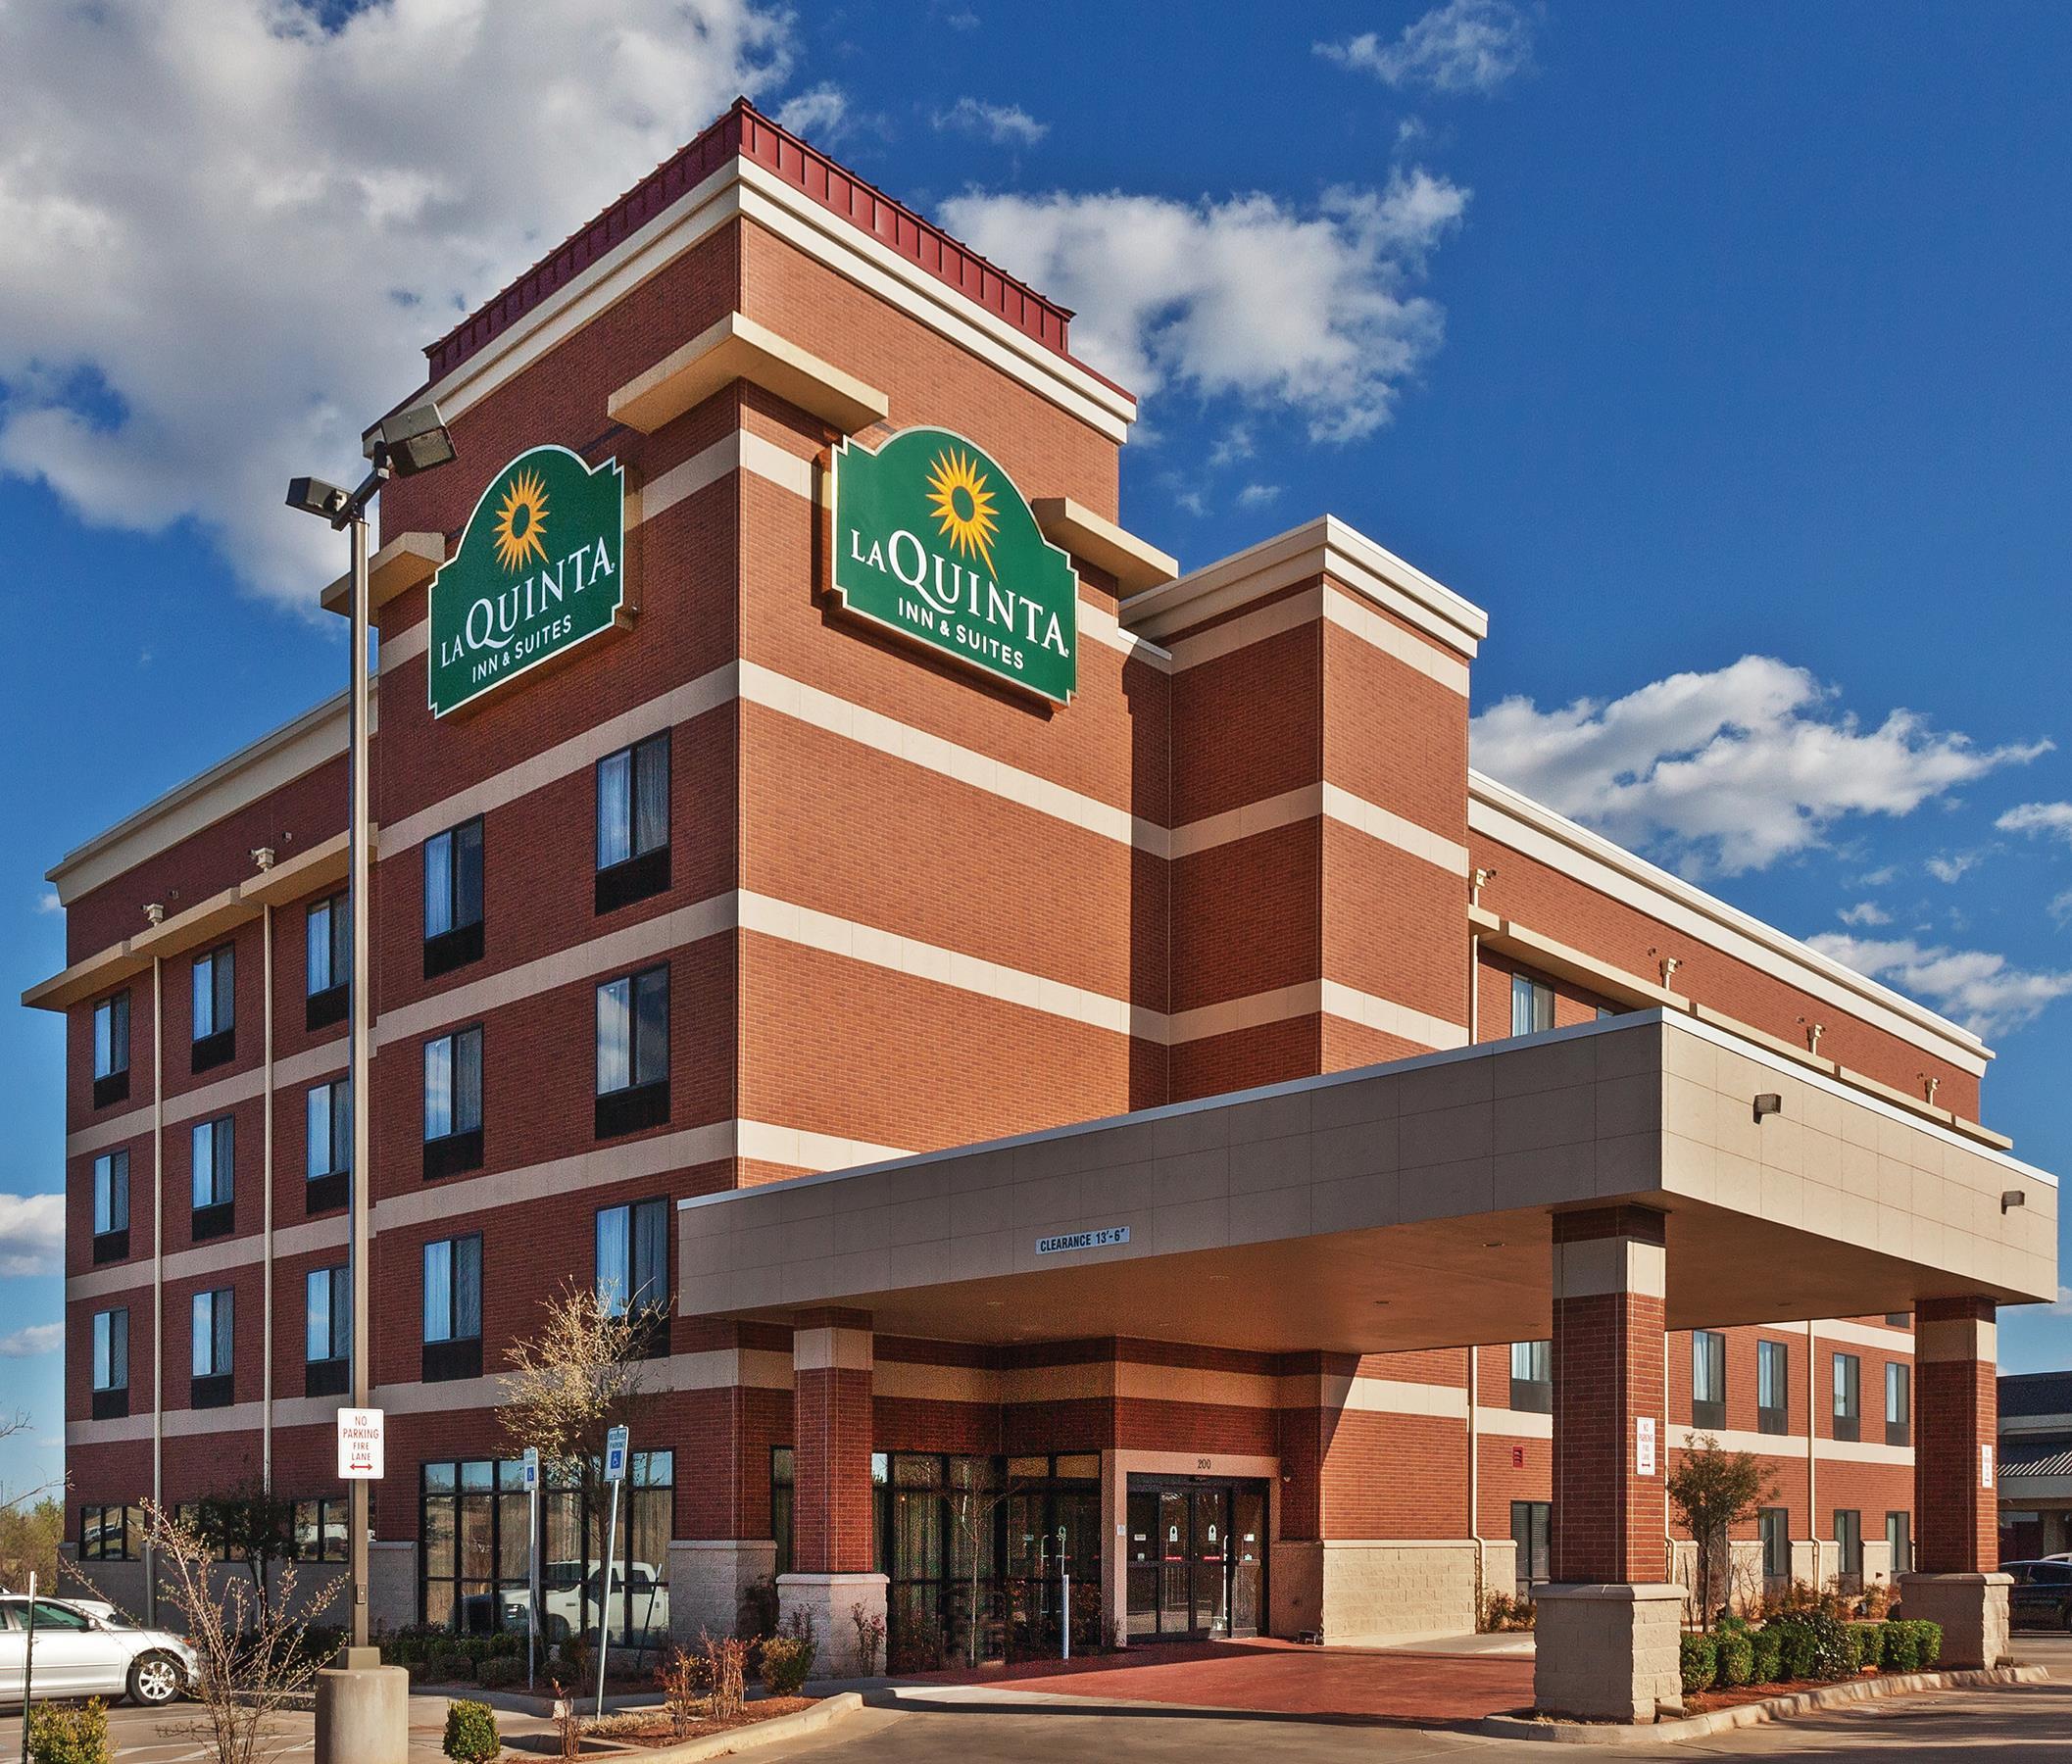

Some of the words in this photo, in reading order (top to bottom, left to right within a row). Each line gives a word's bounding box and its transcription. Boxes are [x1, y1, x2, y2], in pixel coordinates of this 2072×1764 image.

[851, 528, 887, 573] LA
[888, 529, 1068, 658] QUINTA
[441, 634, 466, 667] LA
[466, 537, 614, 649] QUINTA
[898, 597, 934, 630] INN
[939, 619, 951, 637] &
[956, 623, 1024, 670] SUITES
[471, 654, 499, 683] INN
[502, 652, 511, 666] &
[515, 613, 572, 660] SUITES
[1040, 1234, 1091, 1252] CLEARANCE
[355, 1415, 368, 1427] NO
[342, 1428, 379, 1440] PARKING
[353, 1442, 370, 1450] FIRE
[351, 1452, 371, 1461] LANE
[1197, 1458, 1211, 1470] 200
